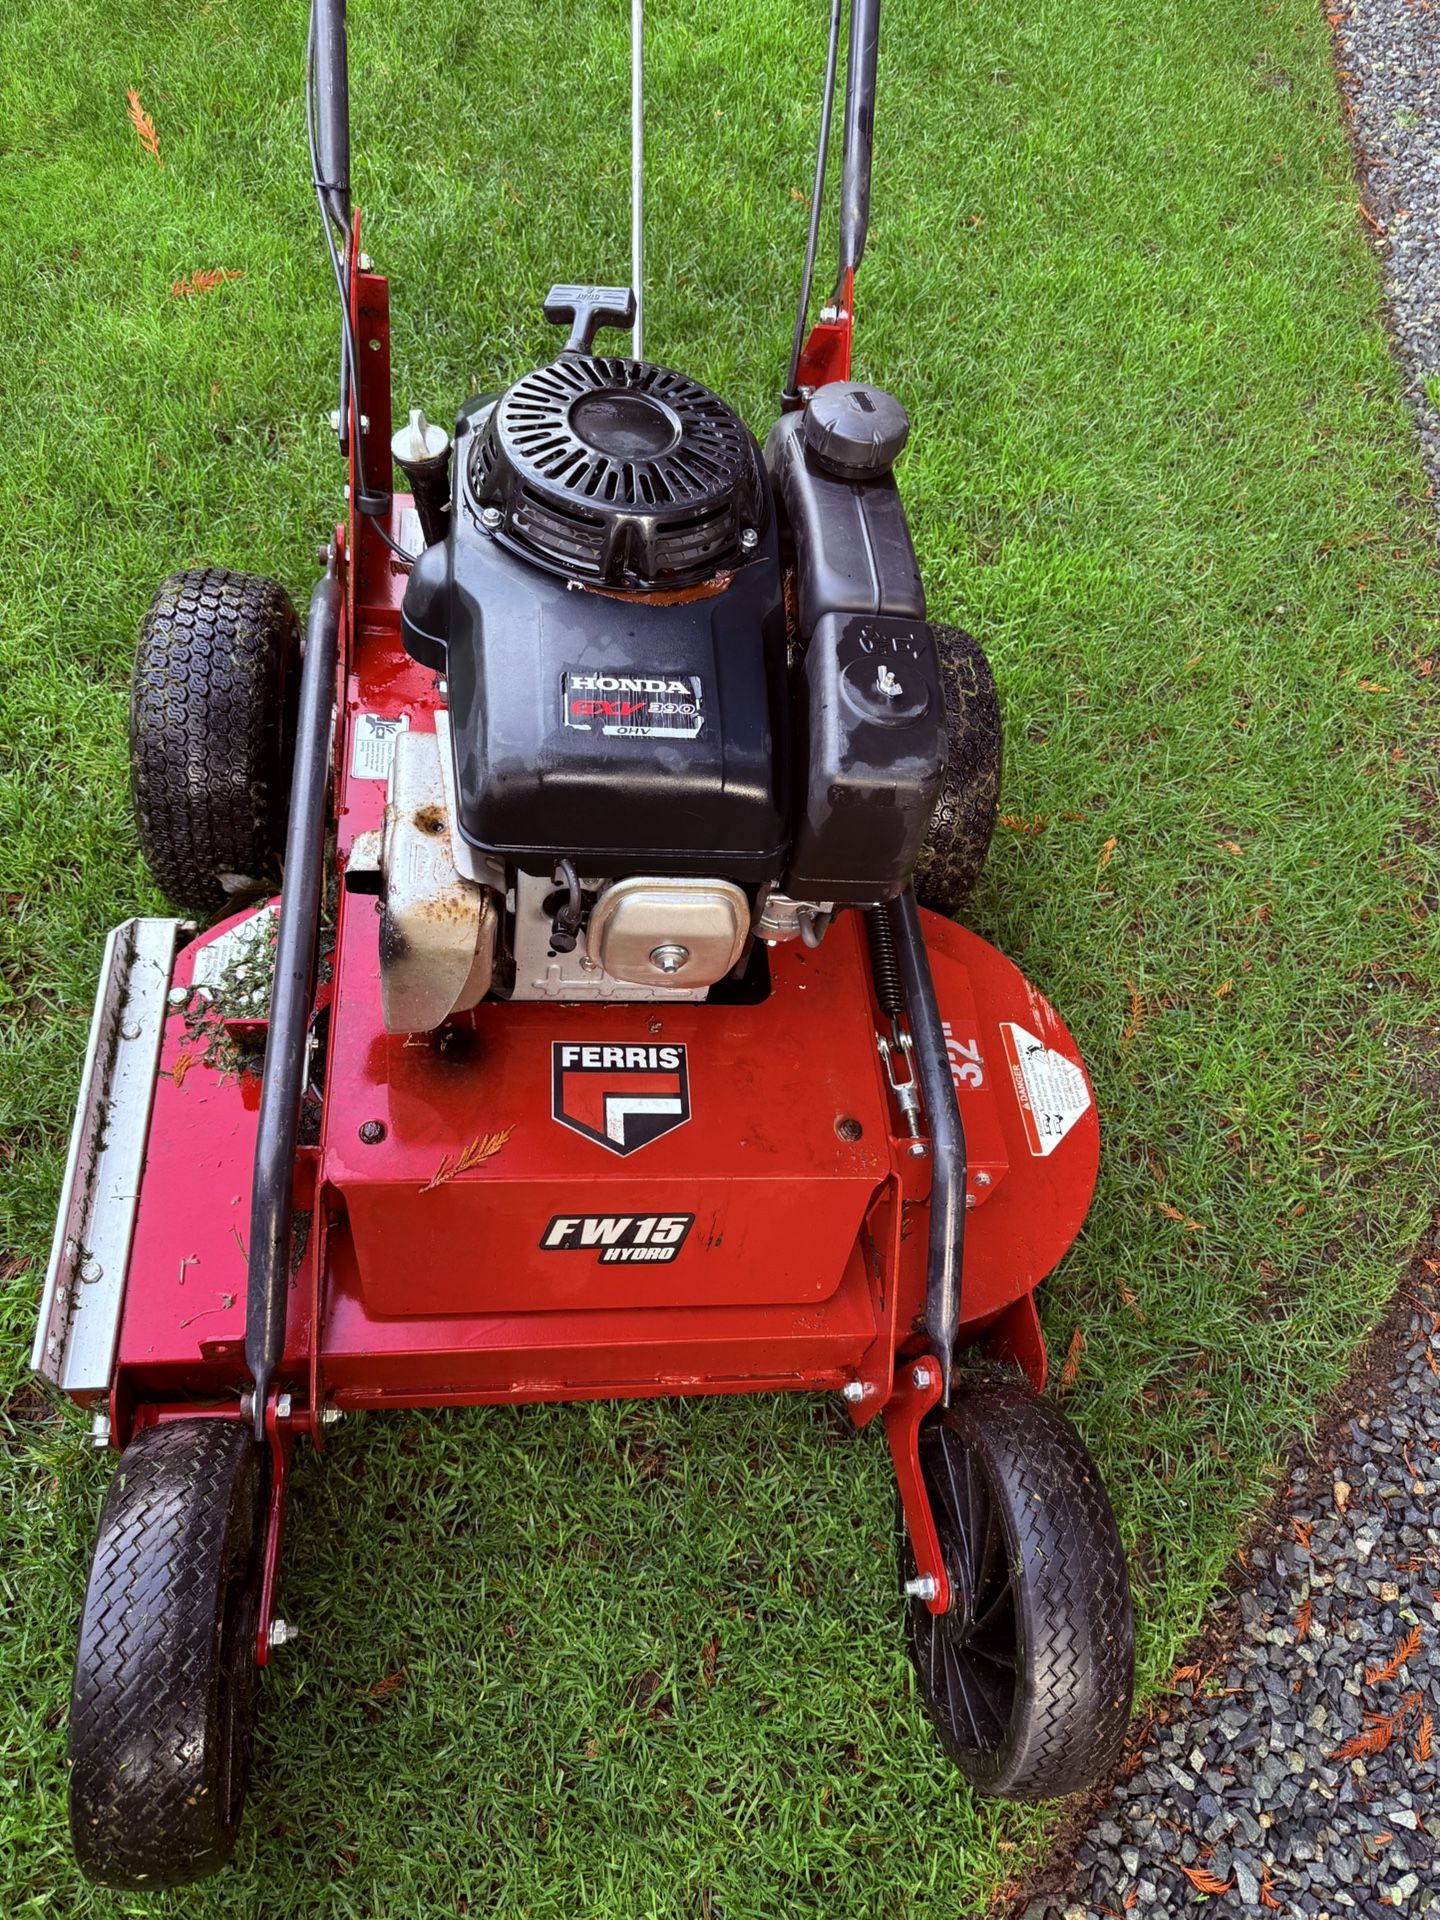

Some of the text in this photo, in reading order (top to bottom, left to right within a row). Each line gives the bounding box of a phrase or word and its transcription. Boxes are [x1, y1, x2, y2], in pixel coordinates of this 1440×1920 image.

[571, 677, 691, 695] HONDA
[570, 699, 696, 716] GXV 390
[616, 726, 651, 736] OHV
[561, 1046, 680, 1069] FERRIS
[941, 1022, 984, 1088] 32"
[1012, 1064, 1029, 1102] DANGER
[603, 1247, 676, 1261] HYDRO
